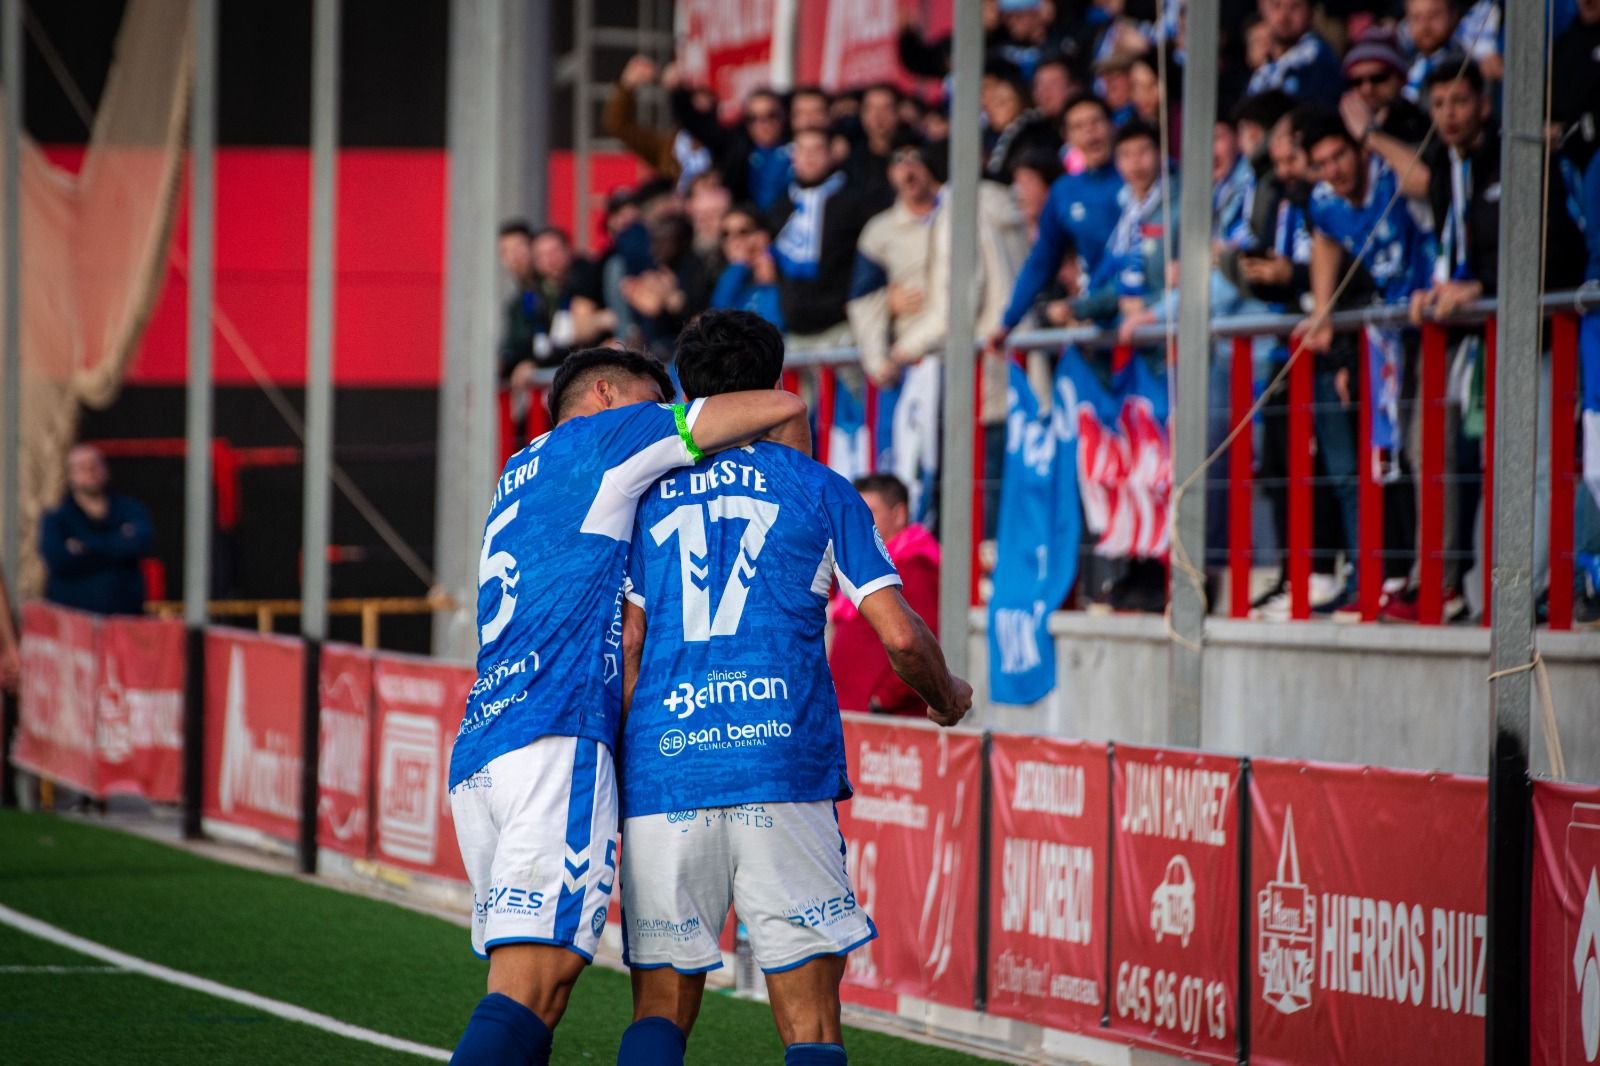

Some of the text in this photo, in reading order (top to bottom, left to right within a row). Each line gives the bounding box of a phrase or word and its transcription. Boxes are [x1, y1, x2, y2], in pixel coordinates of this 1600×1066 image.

[660, 479, 684, 499] C.
[479, 499, 520, 646] 5
[650, 495, 779, 642] 17
[688, 719, 792, 745] san benito
[735, 738, 767, 748] DENTAL
[1320, 893, 1488, 1018] HIERROS RUIZ
[1117, 961, 1151, 1023] 645
[1154, 969, 1177, 1030] 96
[1180, 975, 1203, 1034] 07
[1205, 980, 1226, 1040] 13
